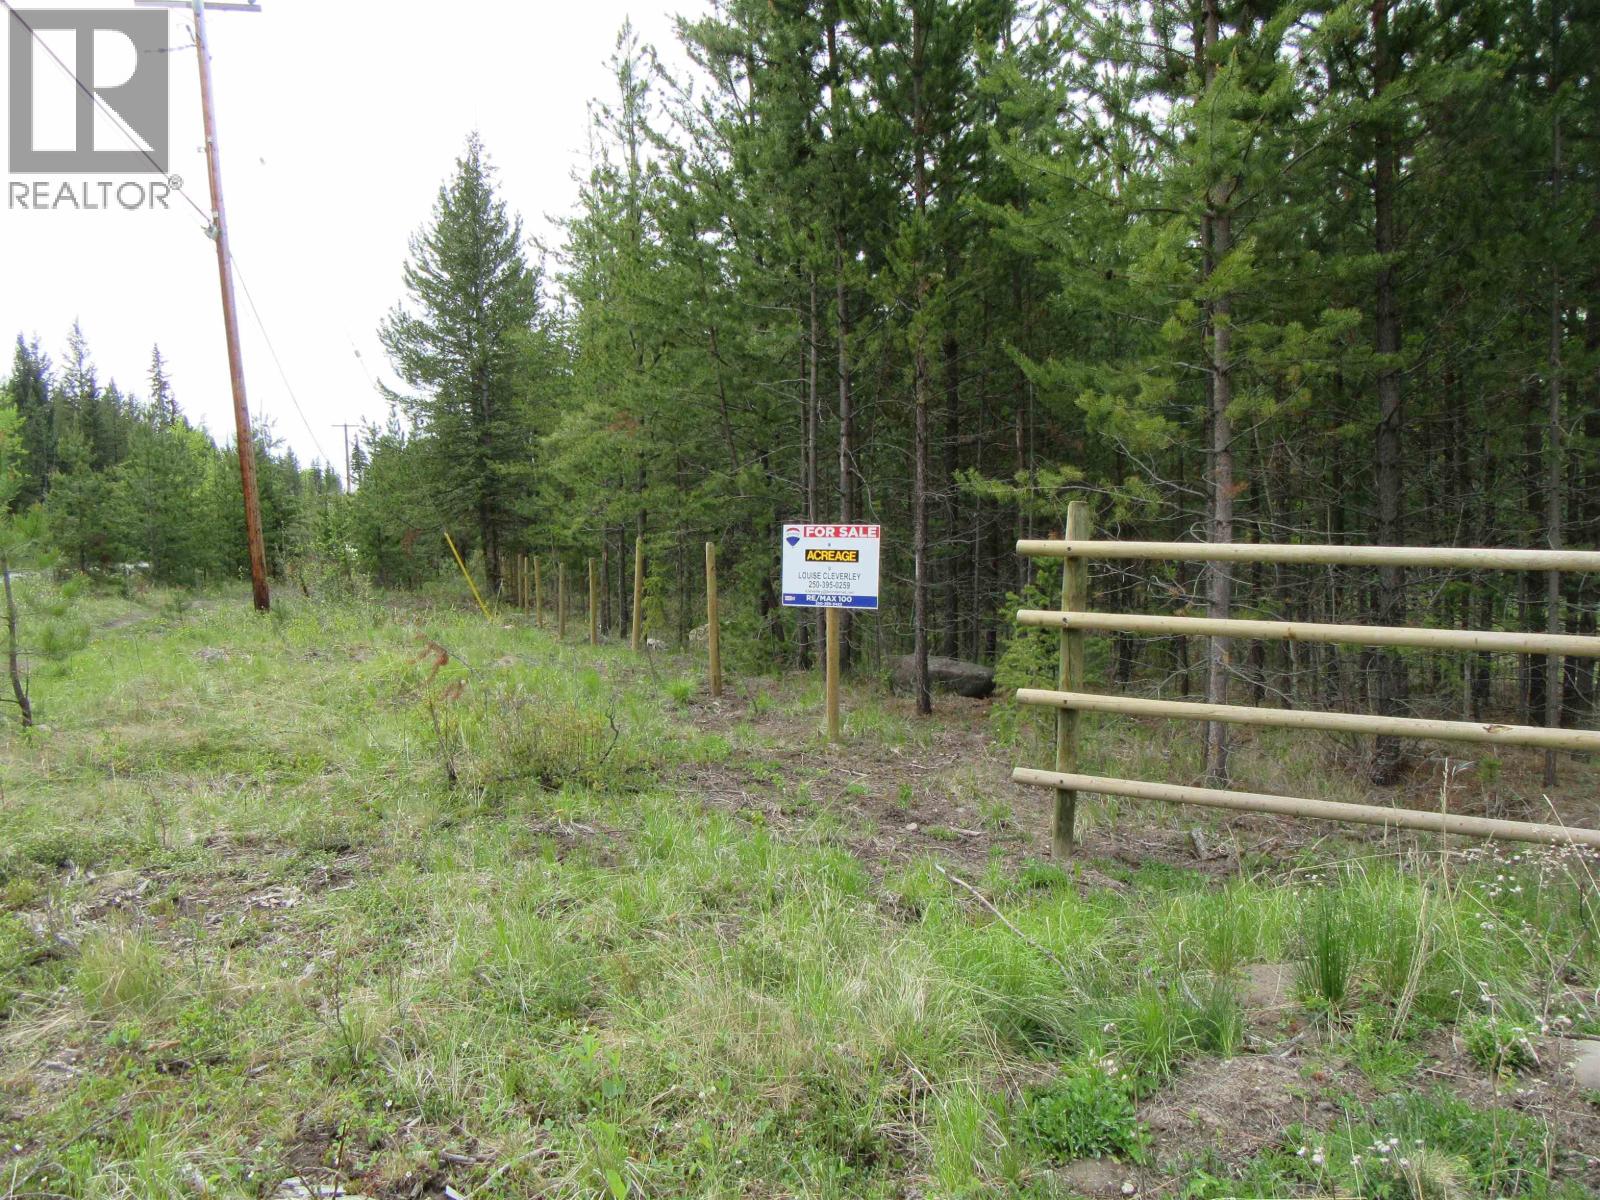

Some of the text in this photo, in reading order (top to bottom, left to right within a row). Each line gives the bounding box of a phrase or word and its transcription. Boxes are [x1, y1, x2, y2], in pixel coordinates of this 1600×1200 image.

[806, 526, 835, 536] FOR
[838, 526, 877, 537] SALE
[807, 550, 856, 562] ACREAGE
[798, 572, 861, 580] LOUISE CLEVERLEY
